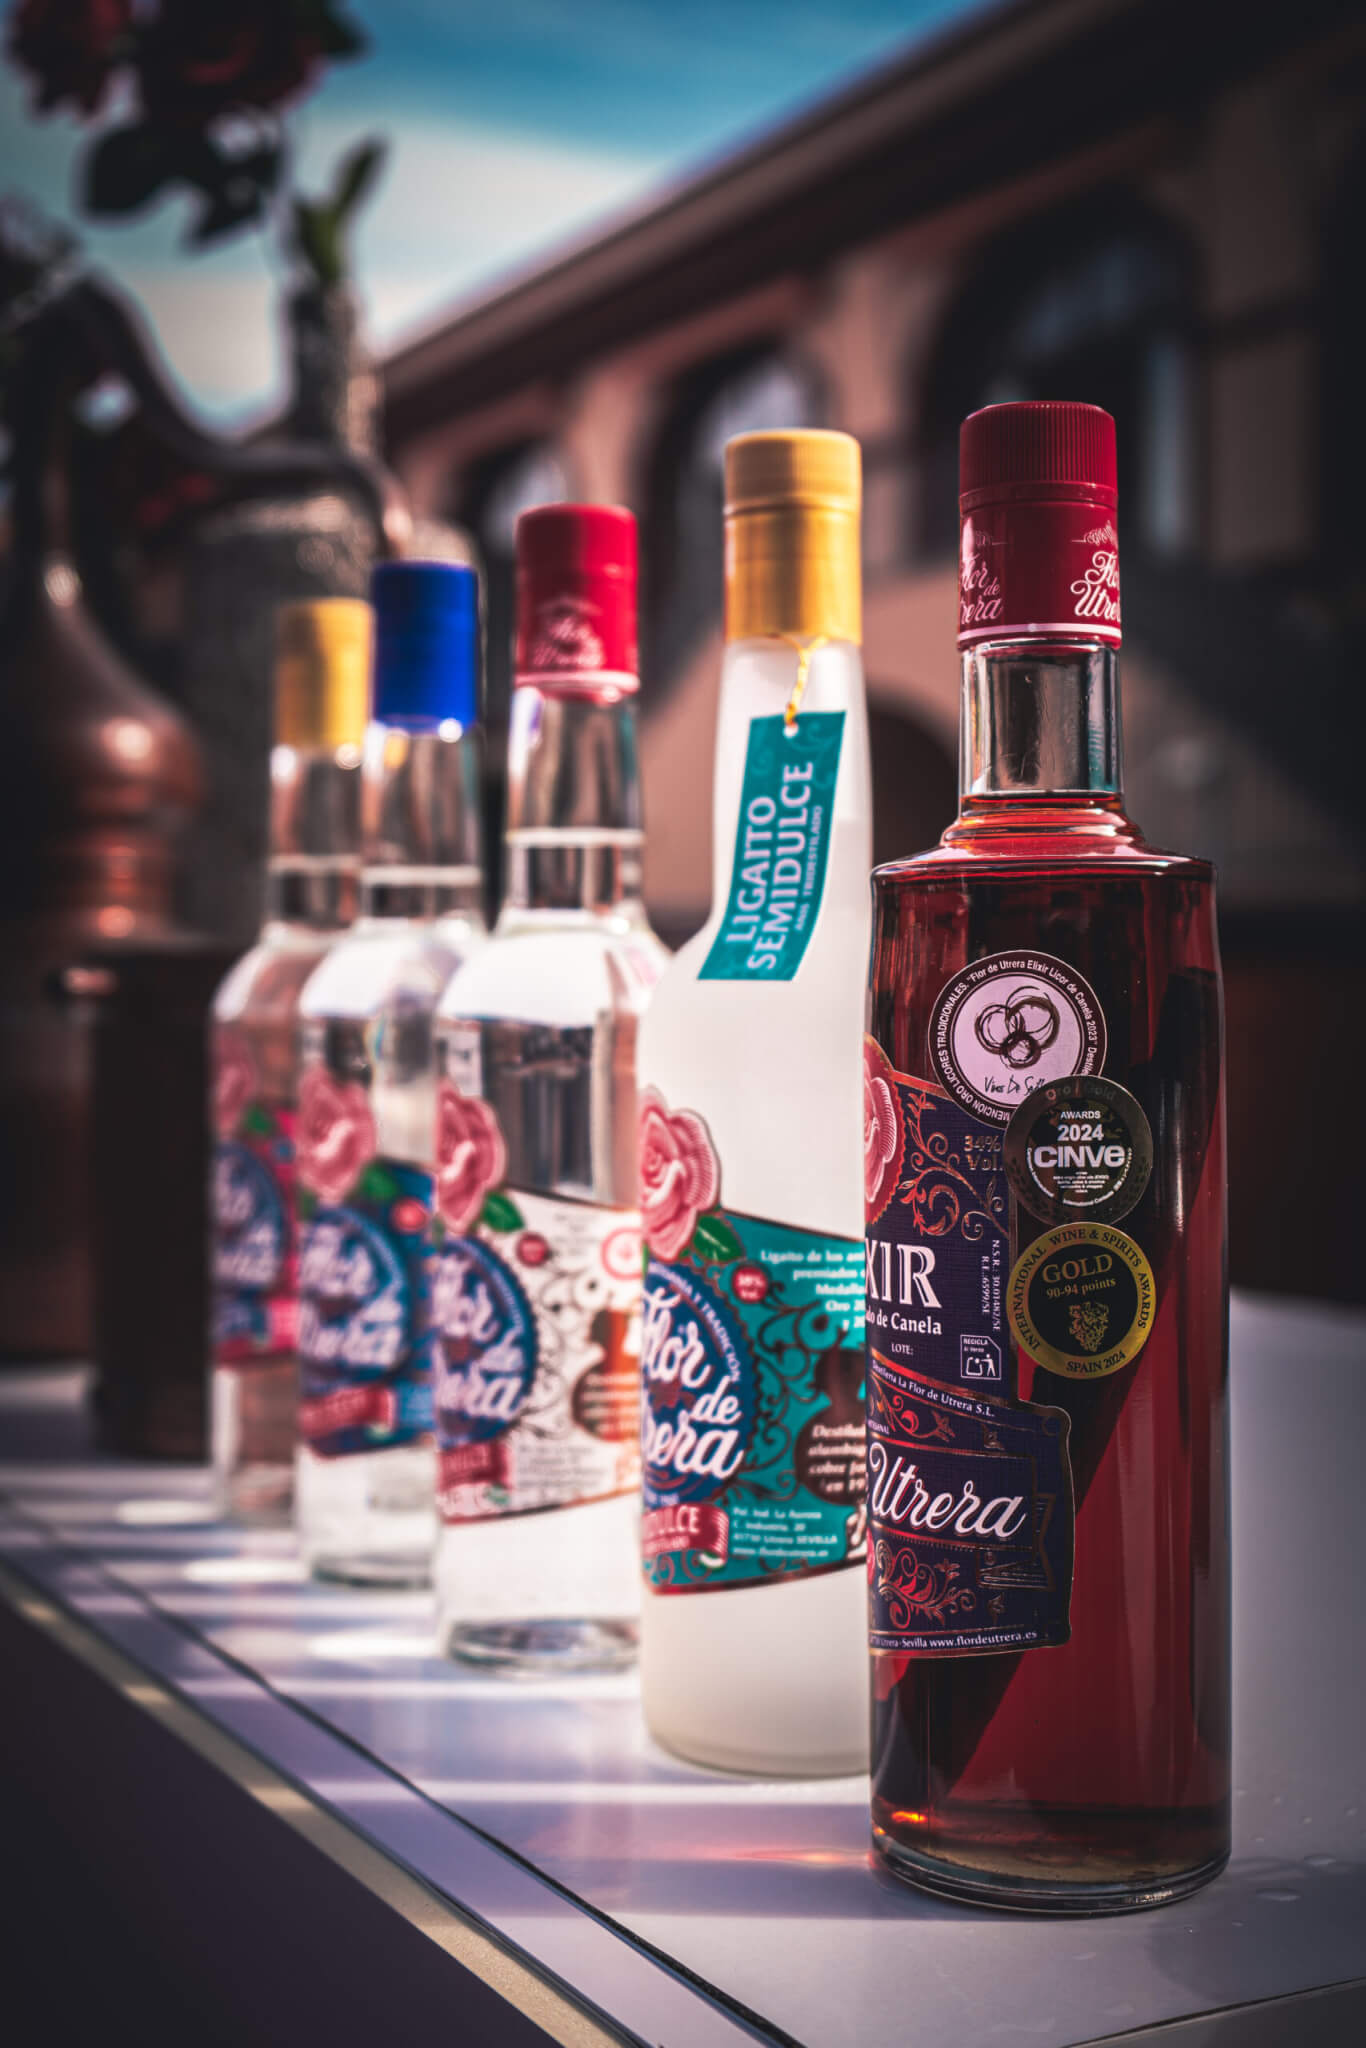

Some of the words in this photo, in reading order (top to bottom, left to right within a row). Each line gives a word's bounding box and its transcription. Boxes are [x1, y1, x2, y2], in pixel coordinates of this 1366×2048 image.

[726, 796, 776, 942] LIGAITO
[747, 762, 813, 969] SEMIDULCE
[987, 964, 998, 973] de
[1000, 960, 1026, 969] Utrera
[1026, 960, 1049, 973] Elixir
[1048, 967, 1069, 985] Licor
[1066, 983, 1077, 993] de
[1074, 992, 1094, 1020] Canela
[938, 1049, 958, 1085] LICORES
[956, 1087, 974, 1104] ORO
[1060, 1111, 1101, 1119] AWARDS
[1057, 1124, 1104, 1142] 2024
[1042, 1253, 1113, 1283] GOLD
[1013, 1246, 1047, 1350] INTERNATIONAL
[1048, 1228, 1086, 1245] WINE
[1088, 1229, 1099, 1240] &
[1102, 1231, 1142, 1268] SPIRITS
[1138, 1272, 1151, 1329] AWARDS
[1046, 1283, 1080, 1299] 90-94
[1081, 1277, 1117, 1296] points
[876, 1308, 888, 1327] de
[890, 1312, 942, 1336] Canela
[891, 1343, 914, 1356] LOTE:
[963, 1337, 989, 1345] RECICLA
[1066, 1360, 1101, 1373] SPAIN
[1103, 1351, 1126, 1369] 2024
[690, 1375, 743, 1425] de
[898, 1376, 908, 1388] La
[909, 1380, 926, 1396] Flor
[927, 1388, 938, 1401] de
[941, 1392, 973, 1412] Utrera
[975, 1404, 996, 1418] S.L.
[869, 1442, 1028, 1539] Utrera
[928, 1630, 1038, 1648] www.flordeutrera.es
